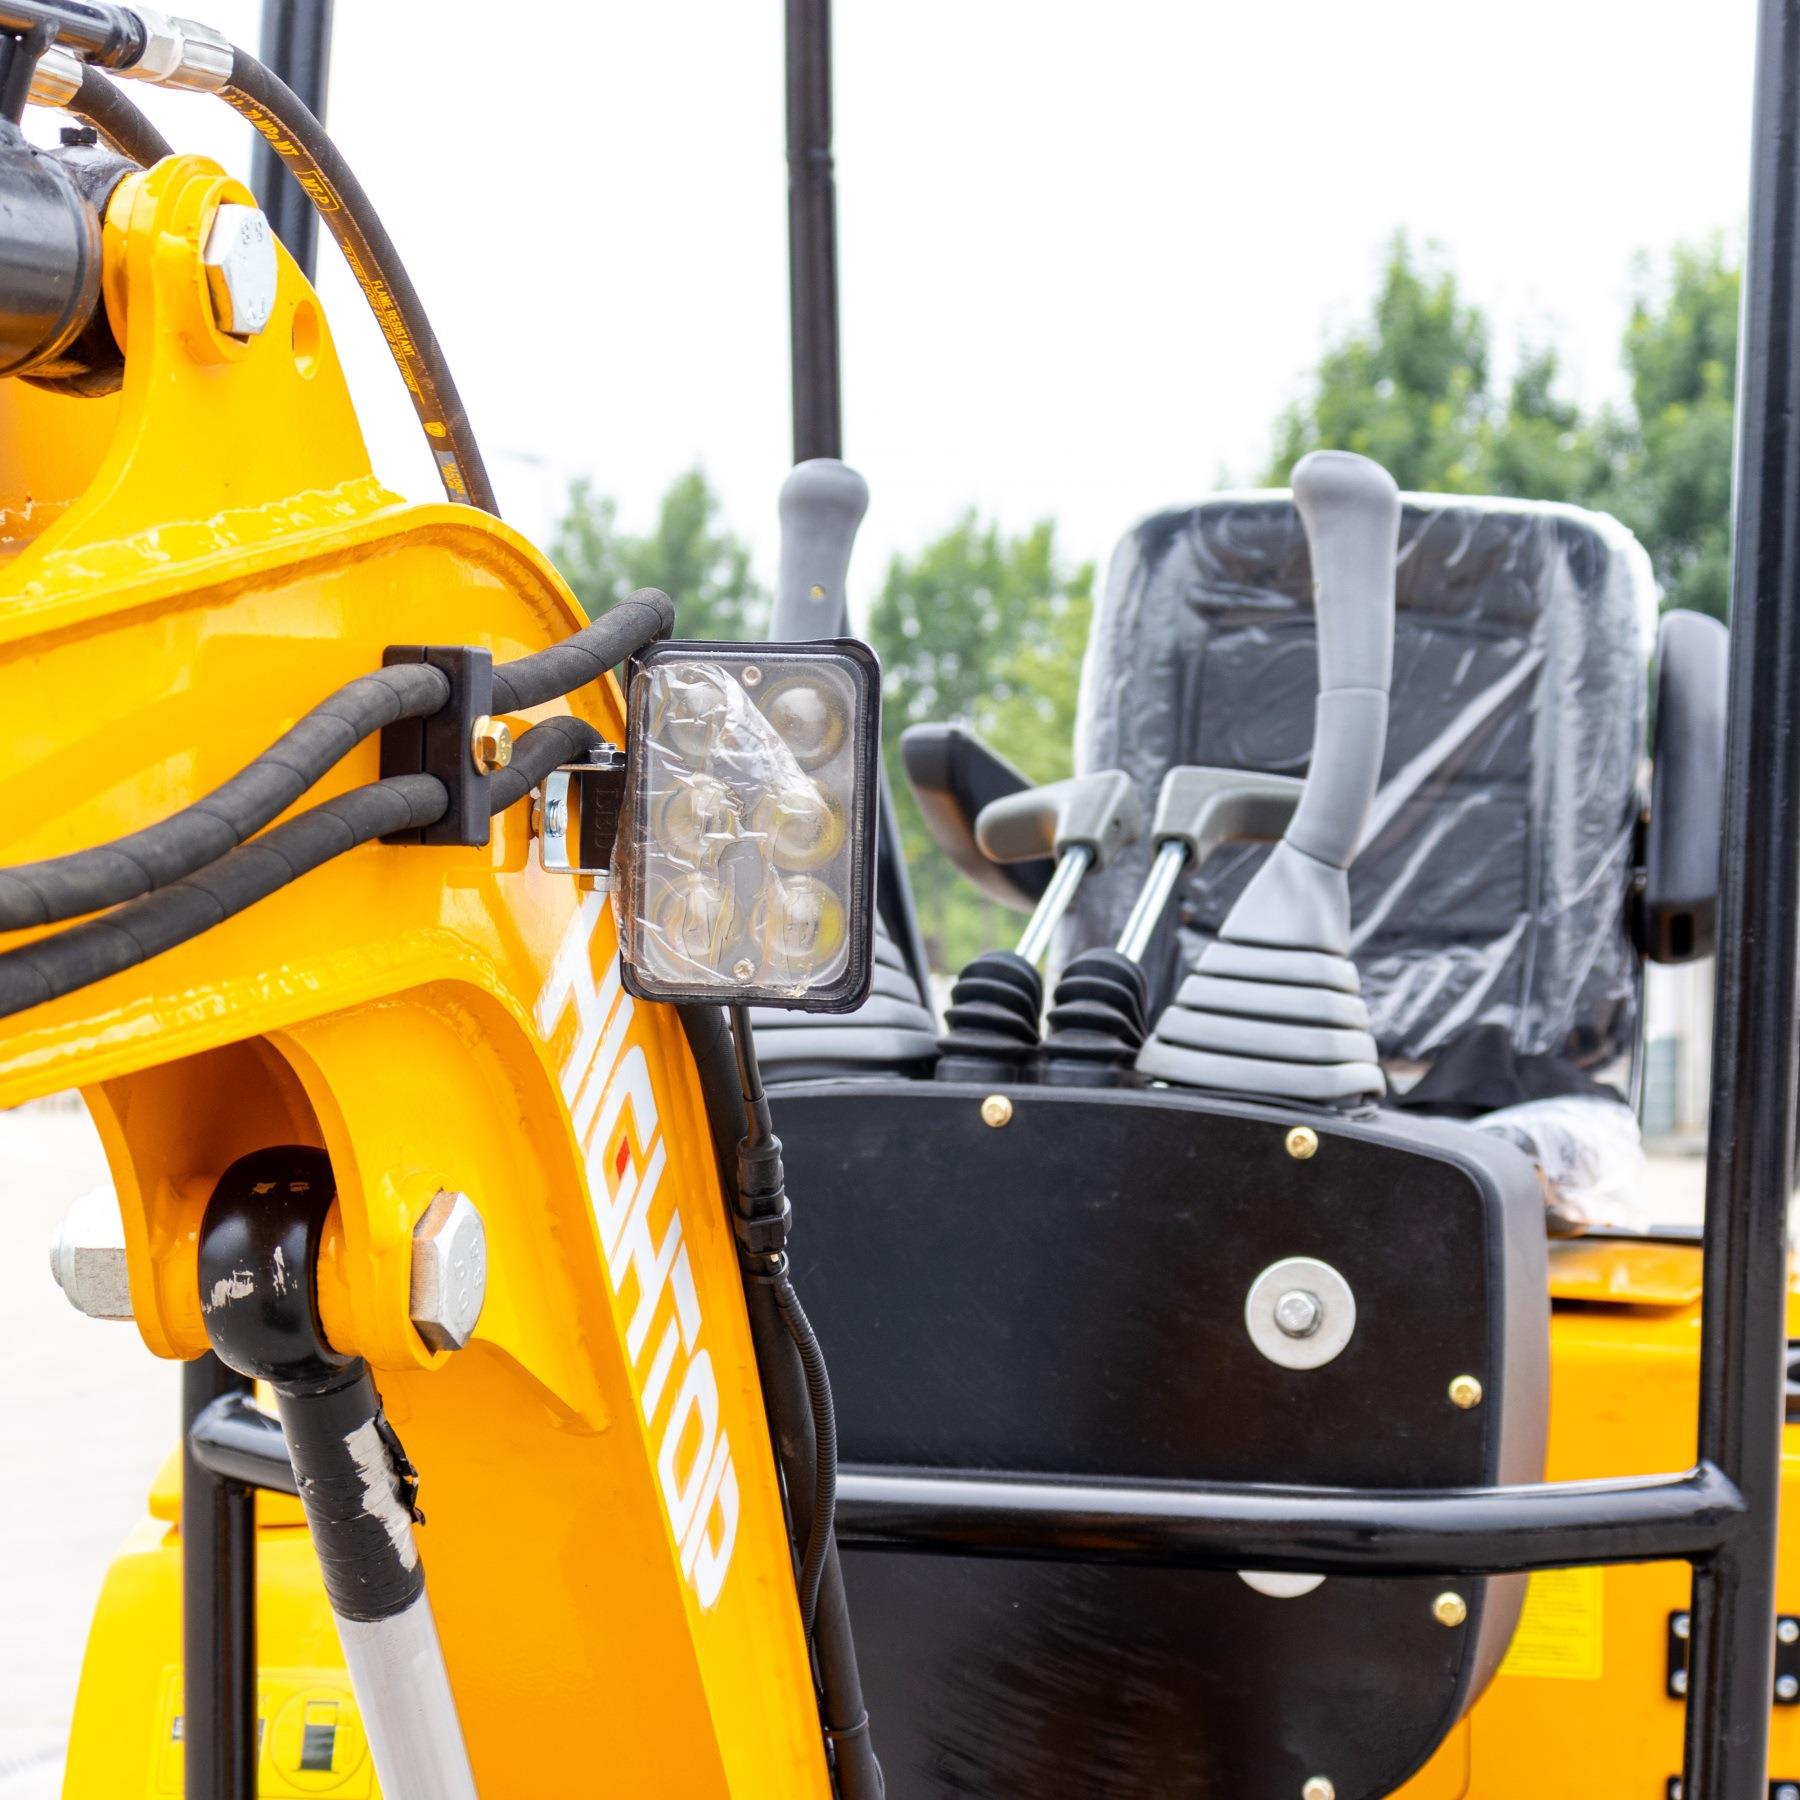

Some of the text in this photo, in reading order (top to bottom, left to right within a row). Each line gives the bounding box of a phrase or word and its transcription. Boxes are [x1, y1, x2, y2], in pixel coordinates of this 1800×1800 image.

[371, 280, 416, 356] FLAME RESISTANT
[532, 886, 739, 1610] HIGHTOP
